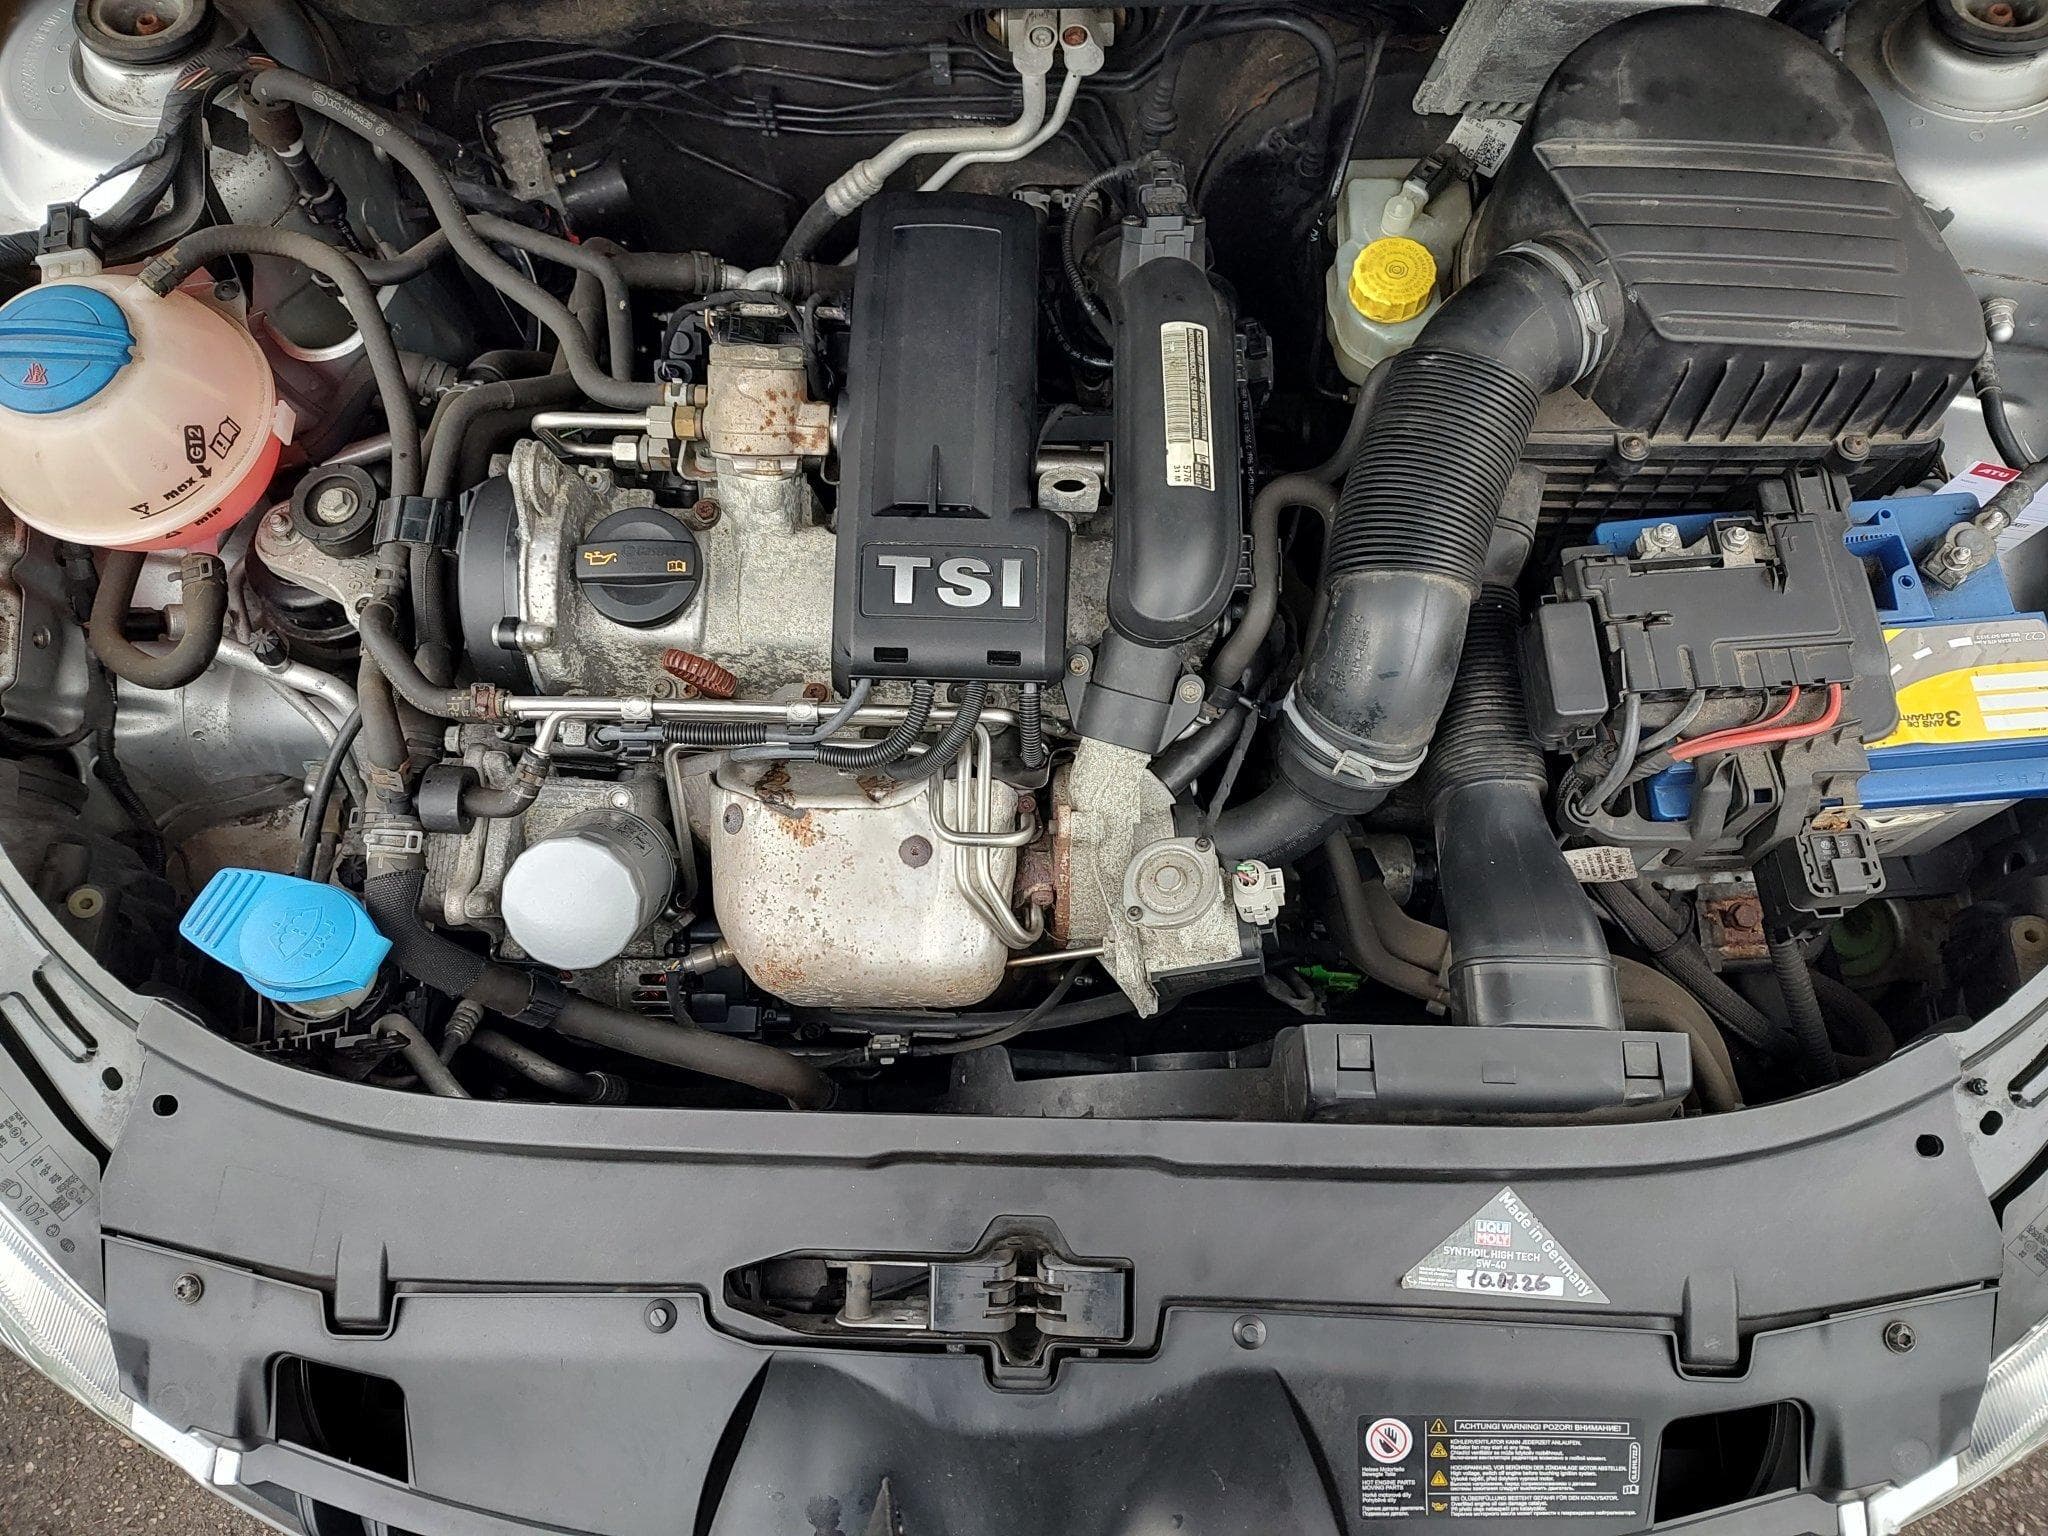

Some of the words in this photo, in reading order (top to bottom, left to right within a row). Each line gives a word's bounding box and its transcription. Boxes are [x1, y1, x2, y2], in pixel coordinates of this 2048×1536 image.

[188, 427, 203, 459] G12
[1977, 468, 2010, 478] ATU
[163, 476, 198, 501] max
[194, 506, 222, 526] min
[878, 555, 1021, 607] TSI
[1908, 719, 1920, 728] DE
[1923, 719, 1945, 728] ANS
[1946, 710, 1961, 727] 3
[1477, 1221, 1510, 1234] LIQUI
[1476, 1233, 1510, 1245] MOLY
[1499, 1191, 1532, 1229] Made
[1528, 1225, 1544, 1243] in
[1541, 1239, 1593, 1297] Germany
[1443, 1246, 1490, 1258] SYNTHOIL
[1491, 1249, 1514, 1260] HIGH
[1515, 1251, 1541, 1262] TECH
[1476, 1259, 1507, 1269] 5W-40
[1459, 1422, 1500, 1430] ACHTUNG!
[1543, 1423, 1573, 1431] POZOR!
